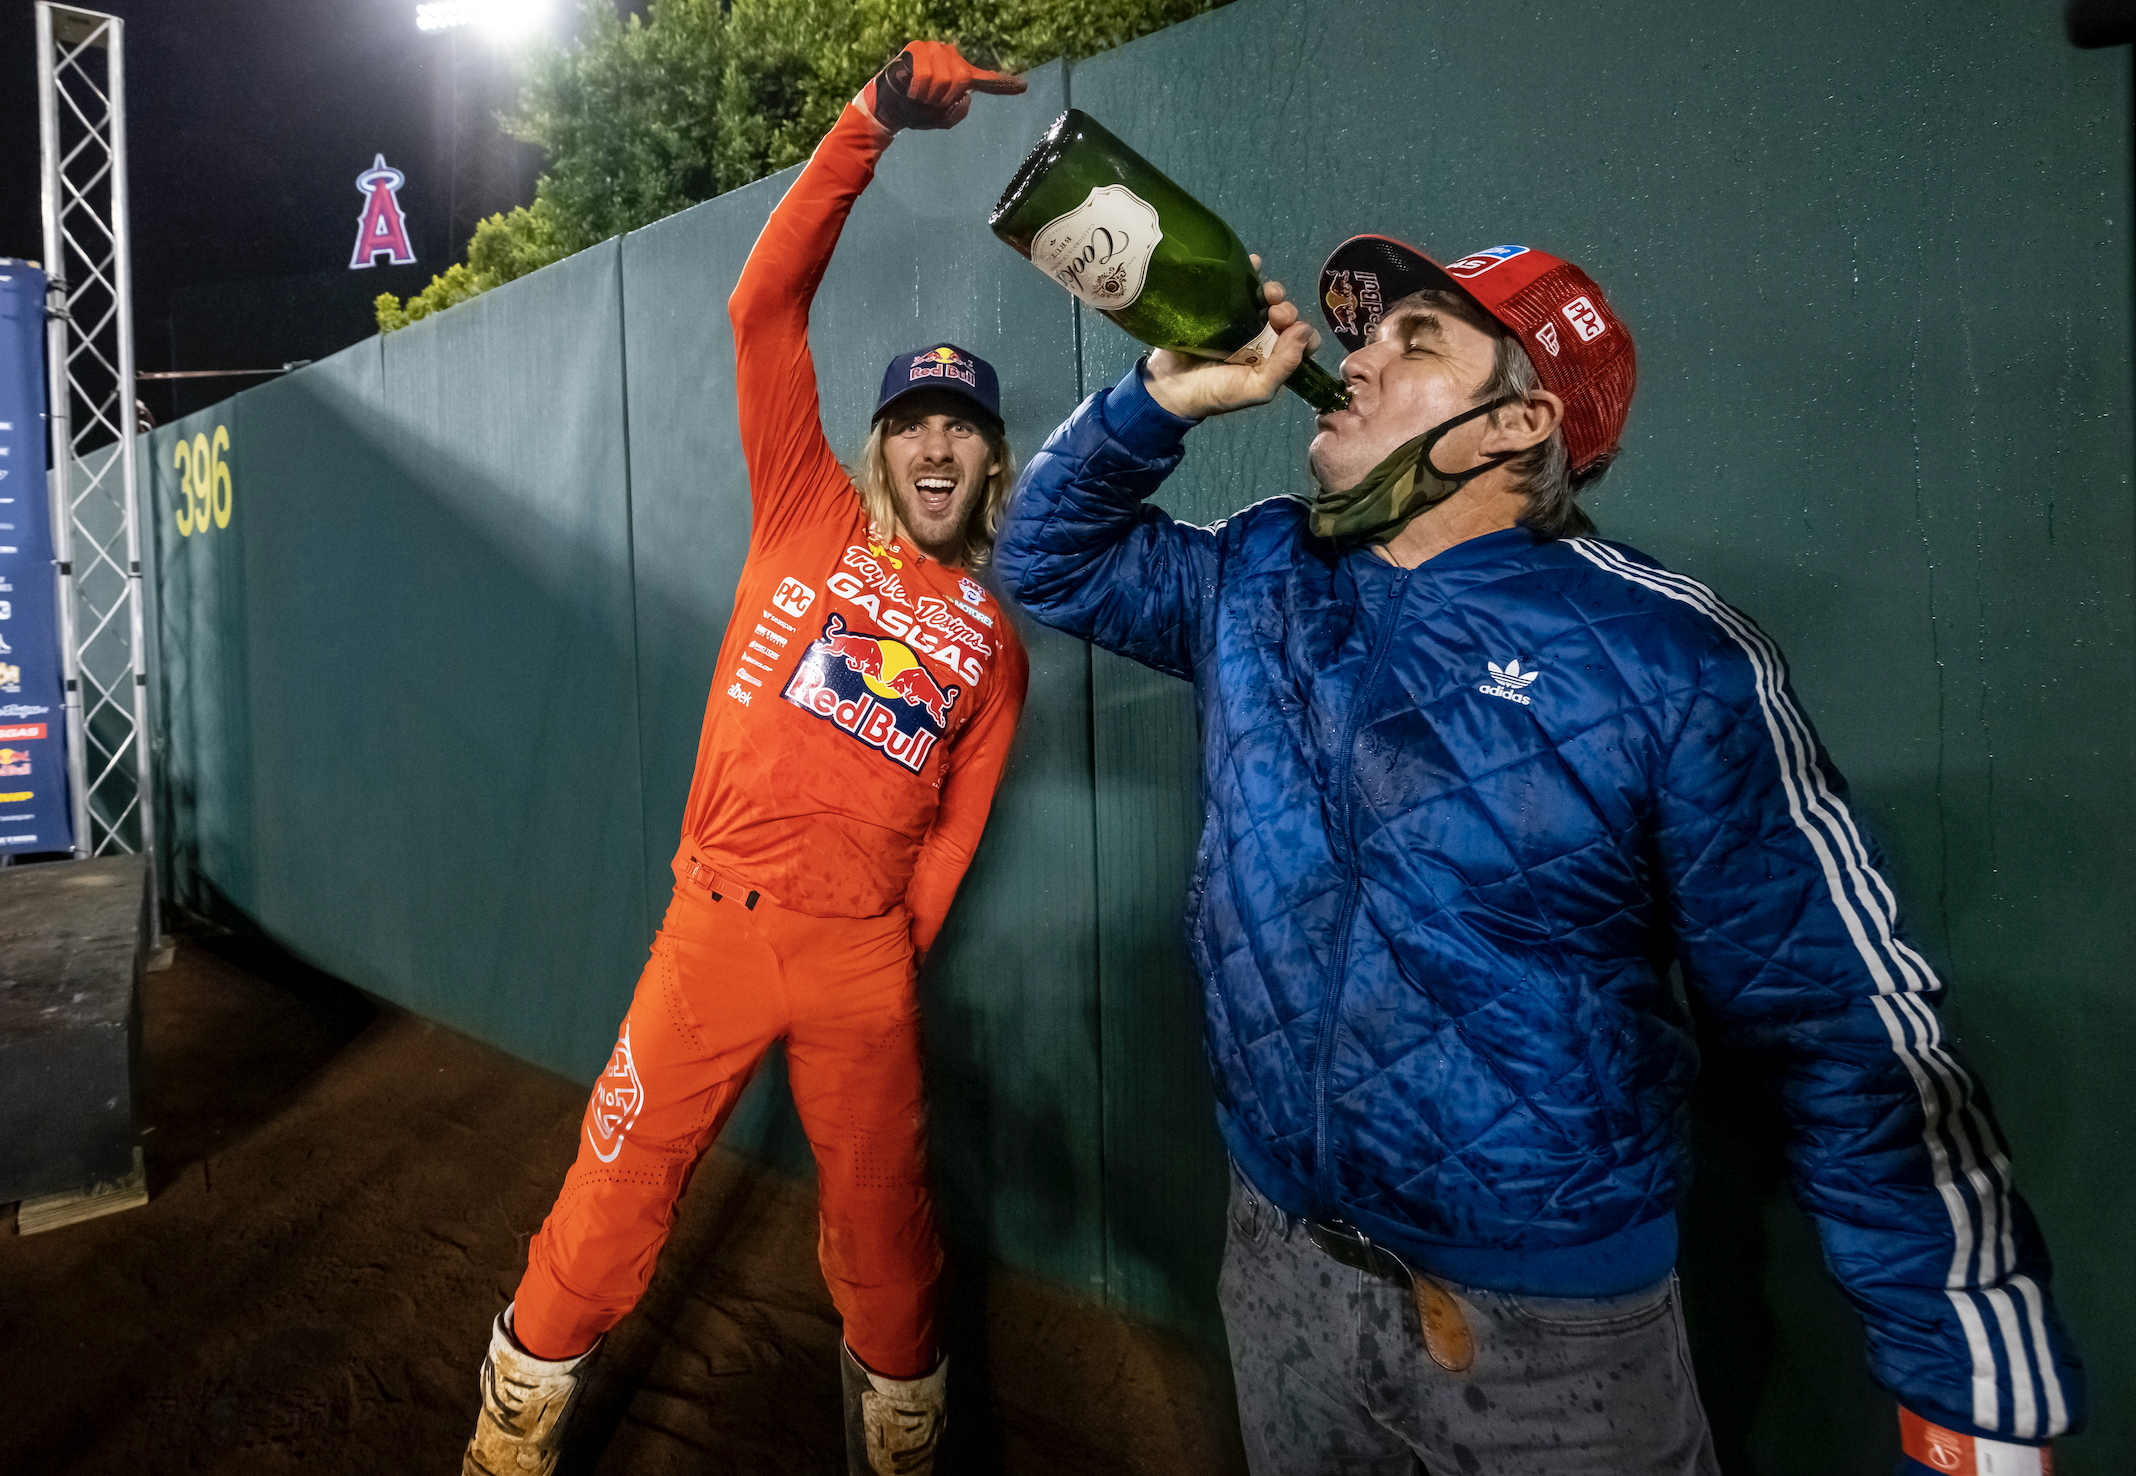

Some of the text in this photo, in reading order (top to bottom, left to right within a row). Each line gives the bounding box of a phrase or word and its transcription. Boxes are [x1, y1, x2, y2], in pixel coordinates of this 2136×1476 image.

[1051, 236, 1073, 258] BRUT
[1353, 270, 1382, 302] Bull
[1566, 300, 1601, 338] PPG
[909, 364, 976, 387] Red Bull
[174, 425, 232, 537] 396
[774, 580, 812, 612] PPG
[843, 545, 887, 588] Troy
[879, 573, 914, 610] Le
[914, 596, 992, 657] Designs
[826, 572, 984, 687] GASGAS
[954, 599, 994, 628] MOTOREX
[1479, 685, 1531, 705] adidas
[784, 661, 938, 772] Red Bull
